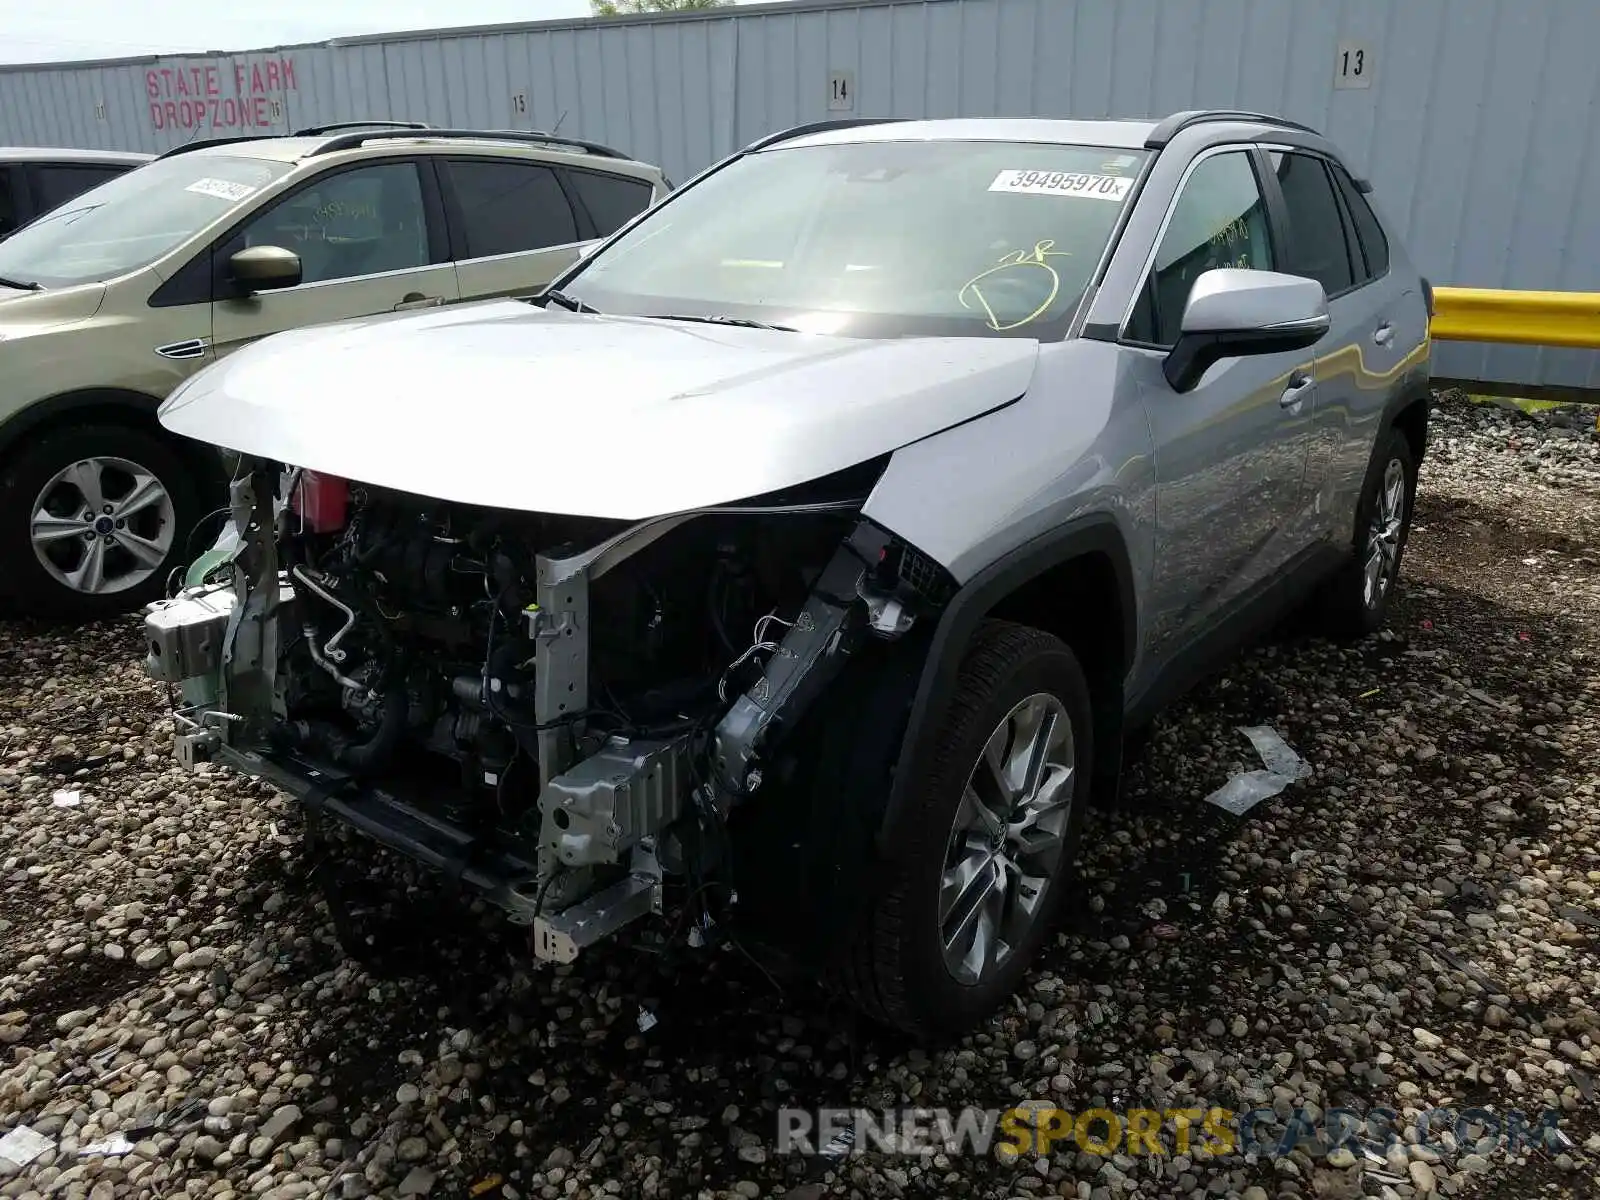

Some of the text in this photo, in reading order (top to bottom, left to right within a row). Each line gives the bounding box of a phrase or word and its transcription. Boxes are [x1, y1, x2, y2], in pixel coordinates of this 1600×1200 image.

[1342, 49, 1364, 76] 13
[146, 58, 297, 98] STATE FARM
[832, 79, 848, 101] 14
[151, 97, 269, 130] DROPZONE
[513, 94, 526, 114] 15
